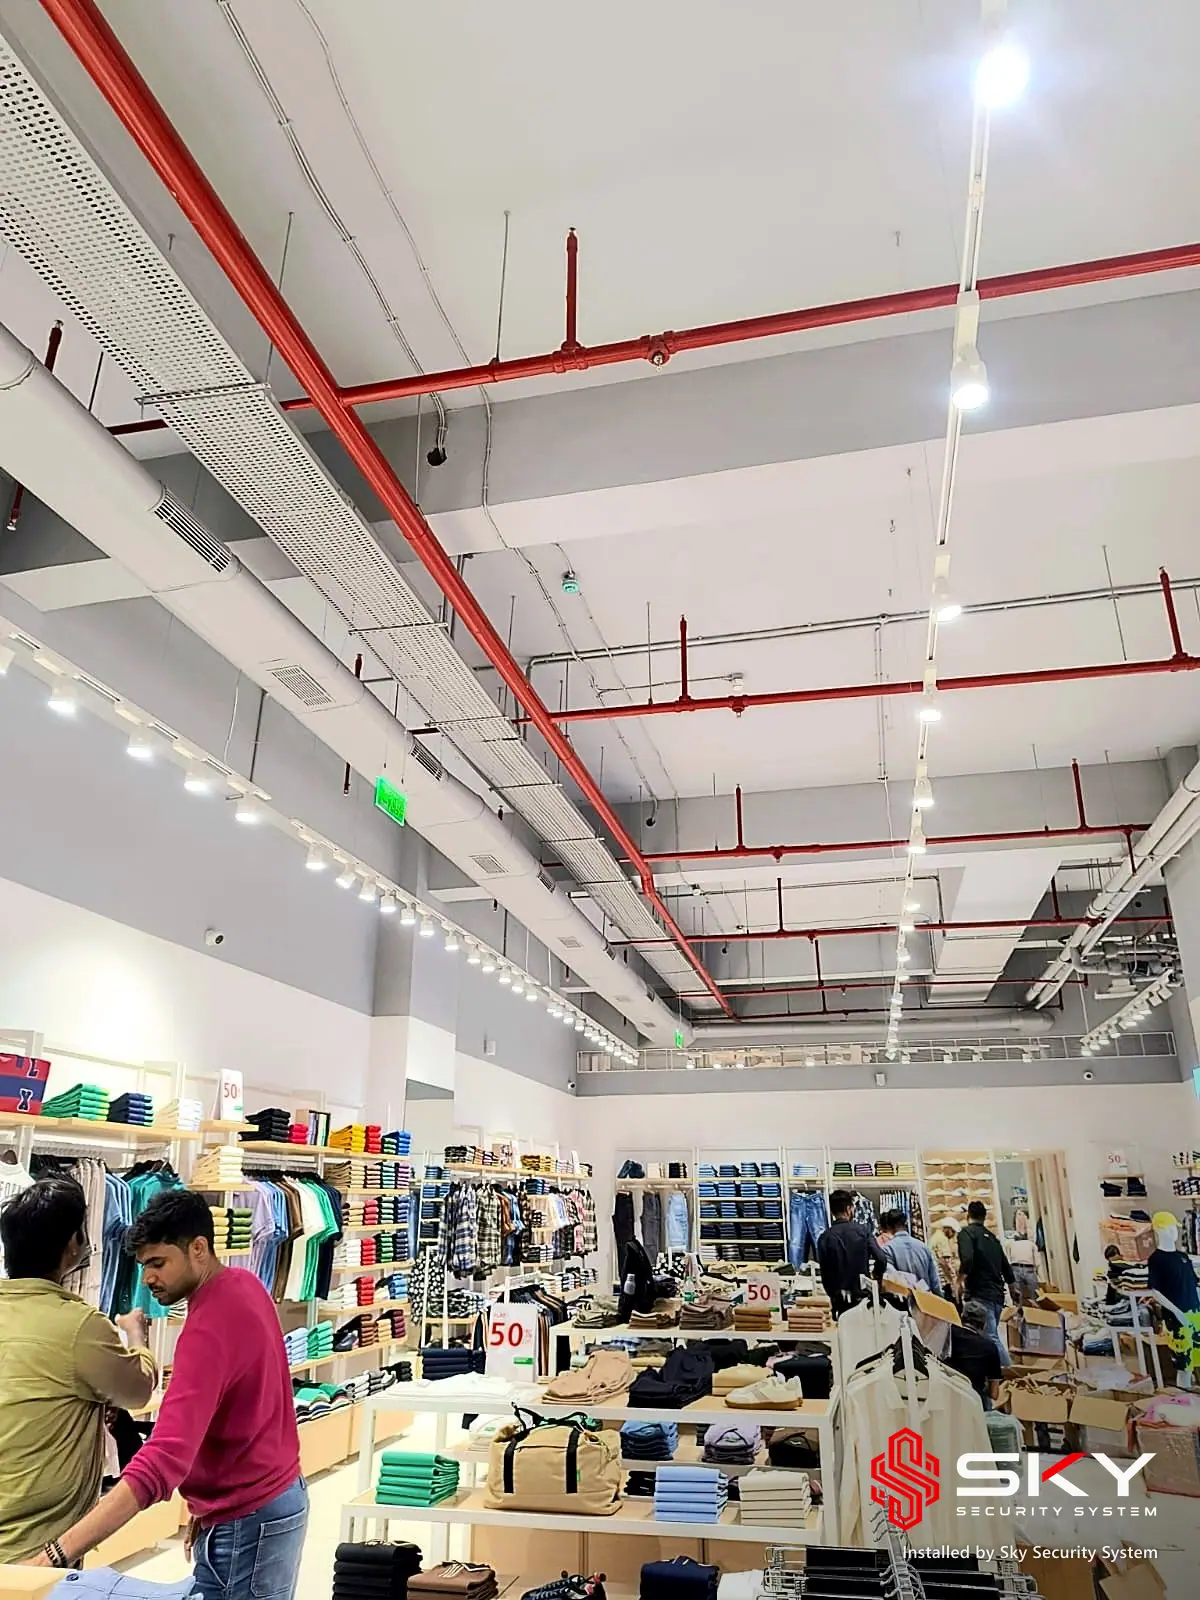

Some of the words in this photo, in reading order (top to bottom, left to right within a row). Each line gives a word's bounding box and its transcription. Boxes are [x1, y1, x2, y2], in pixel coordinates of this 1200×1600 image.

[223, 1082, 238, 1099] 50
[747, 1284, 771, 1301] 50
[490, 1322, 524, 1347] 50
